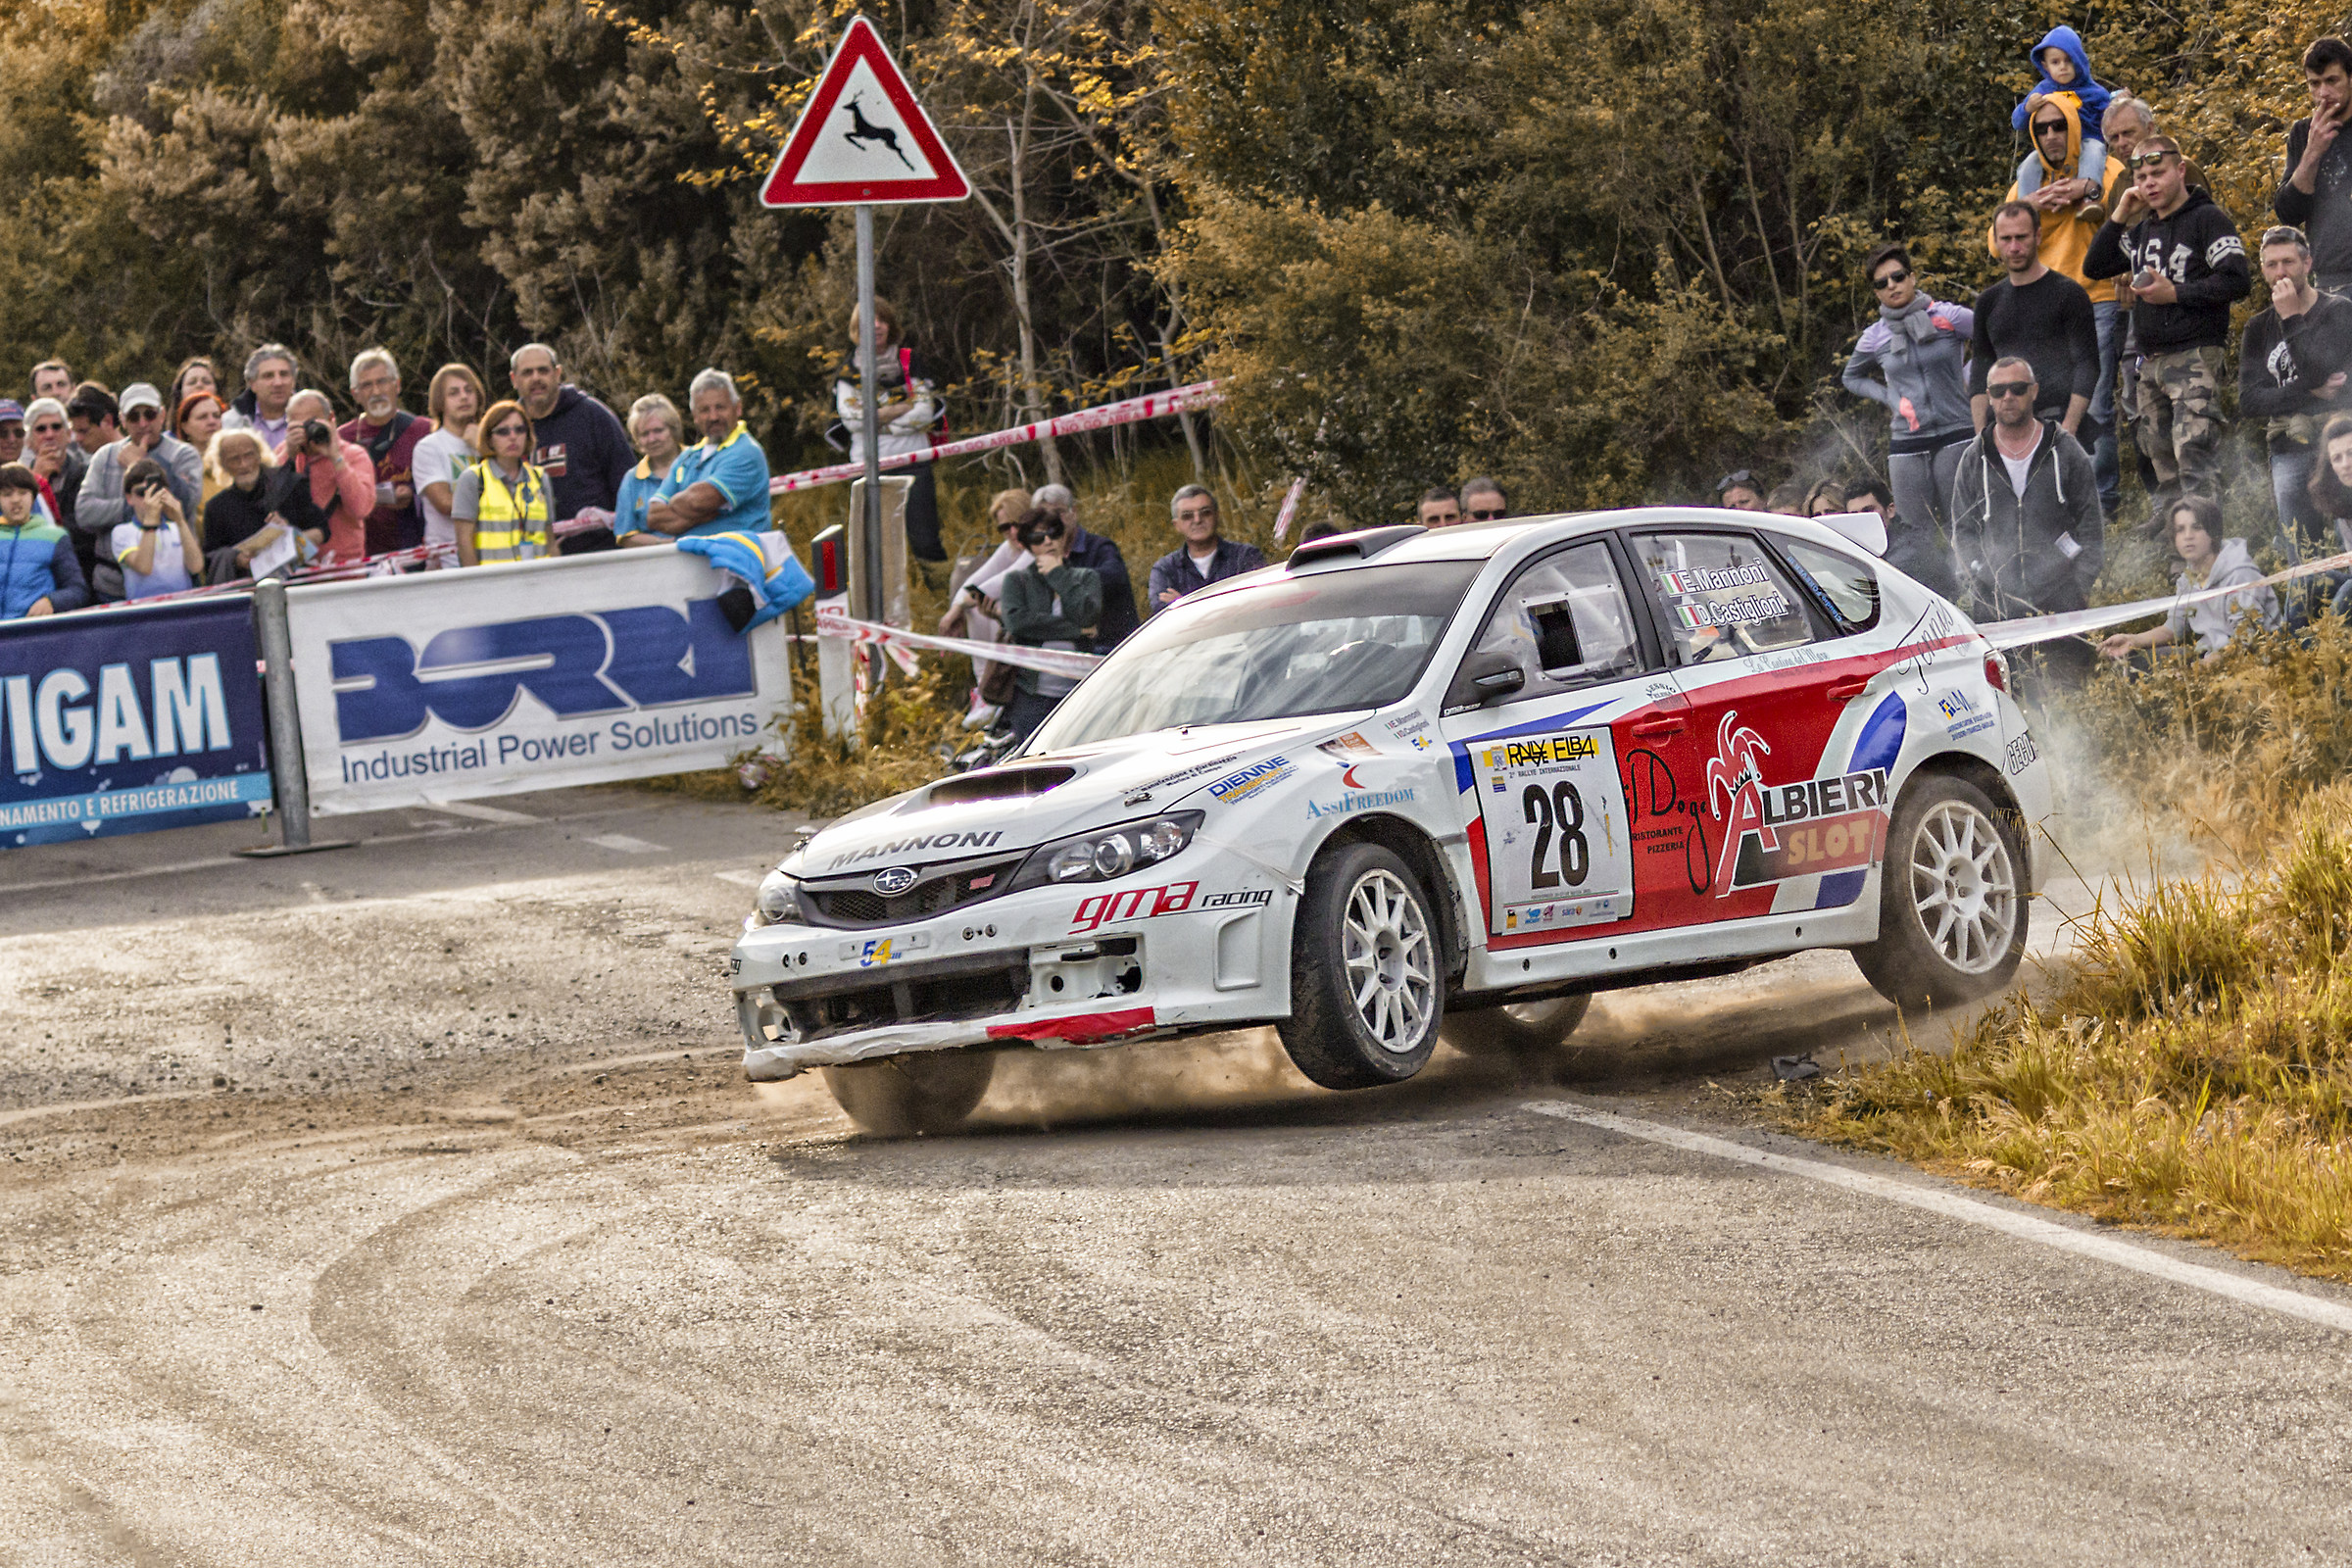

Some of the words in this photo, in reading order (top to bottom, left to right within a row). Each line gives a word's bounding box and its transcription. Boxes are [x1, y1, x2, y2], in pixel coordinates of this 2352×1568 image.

[1061, 422, 1080, 433] NO
[1084, 418, 1102, 429] GO
[1106, 412, 1143, 426] AREA
[942, 442, 961, 455] NO
[965, 439, 986, 450] GO
[990, 433, 1025, 448] AREA
[1678, 558, 1769, 594] E.Mannoni
[1695, 591, 1788, 627] D.Castiglioni
[0, 652, 231, 775] IGAM
[340, 738, 488, 783] Industrial
[498, 728, 601, 765] Power
[611, 711, 759, 751] Solutions
[1552, 735, 1595, 762] ELBA
[1207, 756, 1291, 798] DIENNE
[1217, 766, 1285, 804] TRANSPORT
[0, 801, 80, 826] NAMENTO
[85, 798, 95, 816] E
[100, 780, 239, 815] REFRIGERAZIONE
[828, 830, 1005, 871] MANNONI
[1522, 780, 1590, 890] 28
[1632, 826, 1684, 841] RISTORANTE
[1647, 841, 1686, 854] PIZZERIA
[1715, 768, 1889, 899] ALBIERI
[1787, 817, 1873, 865] SLOT
[1067, 880, 1200, 935] gma
[1201, 889, 1273, 906] racing
[860, 939, 893, 967] 54
